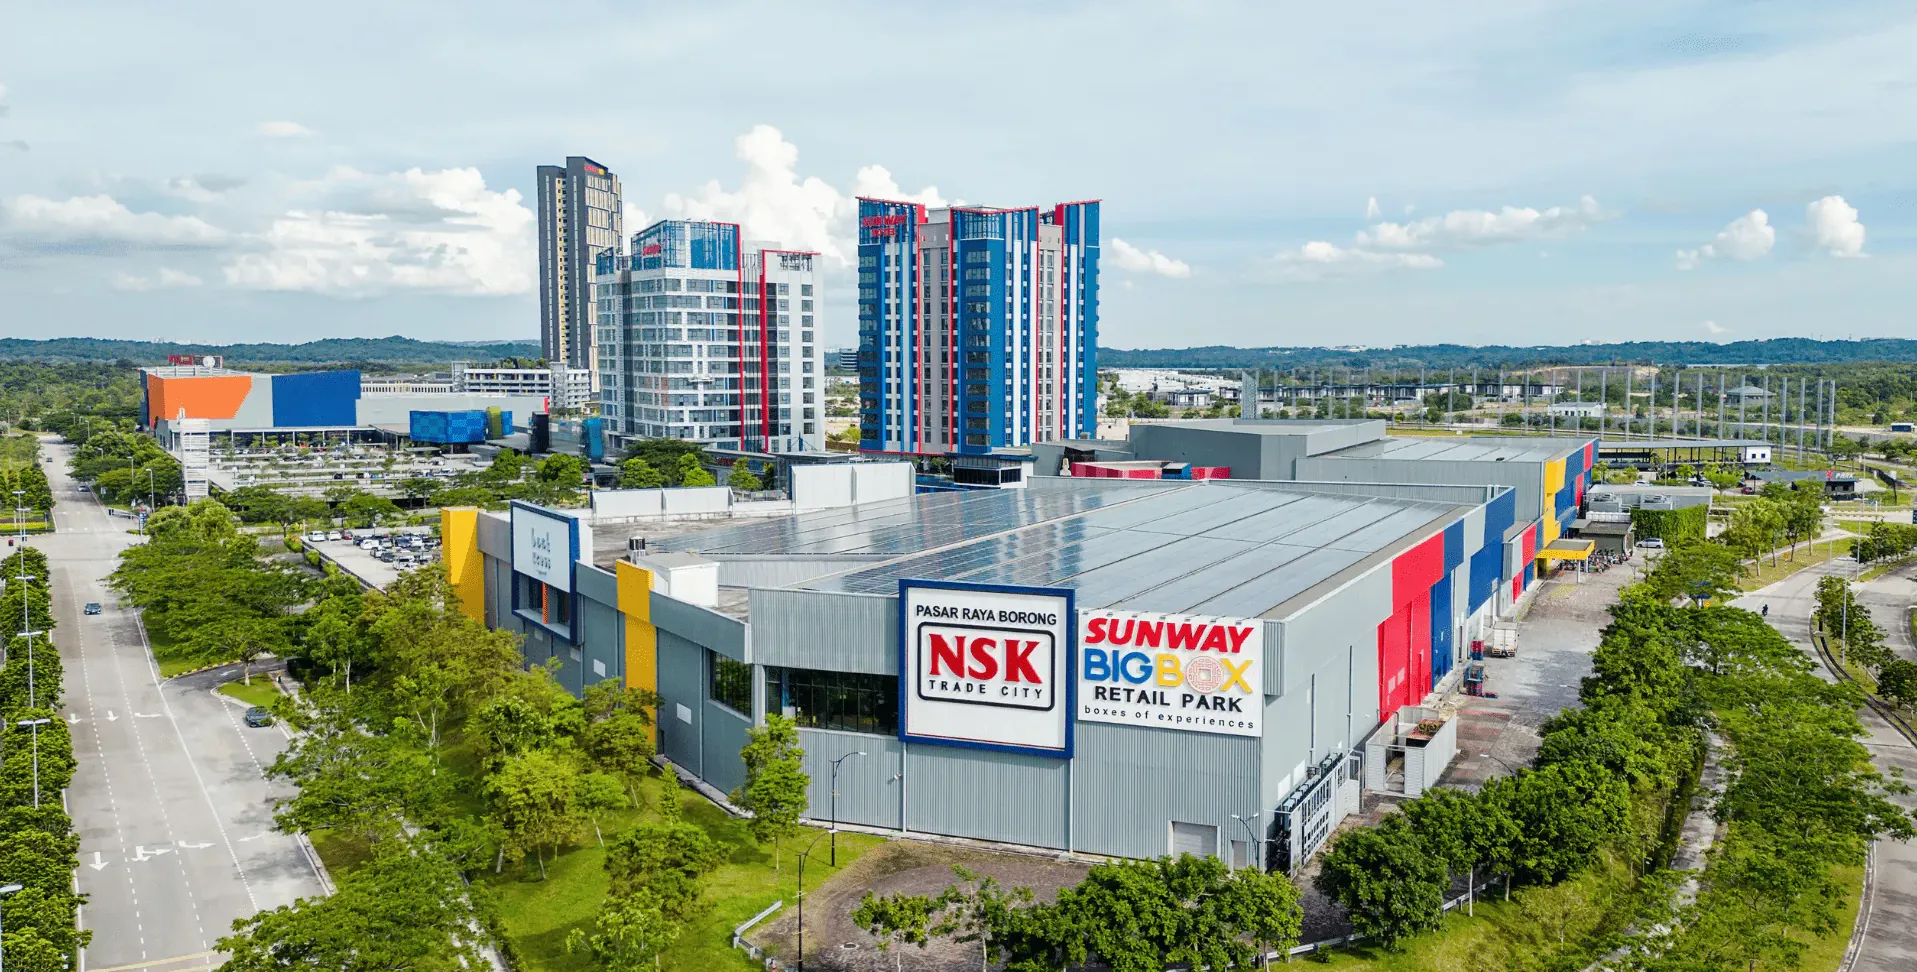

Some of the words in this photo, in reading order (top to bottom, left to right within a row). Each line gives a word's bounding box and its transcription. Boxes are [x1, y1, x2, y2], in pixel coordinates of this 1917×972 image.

[916, 605, 958, 619] PASAR
[962, 608, 996, 622] RAYA
[999, 610, 1057, 626] BORONG
[1085, 617, 1254, 654] SUNWAY
[928, 633, 1043, 684] NSK
[929, 680, 986, 694] TRADE
[1001, 686, 1042, 699] CITY
[1094, 685, 1171, 707] RETAIL
[1181, 693, 1243, 713] PARK
[1084, 705, 1126, 717] boxes
[1135, 710, 1149, 720] of
[1158, 713, 1254, 729] experiences
